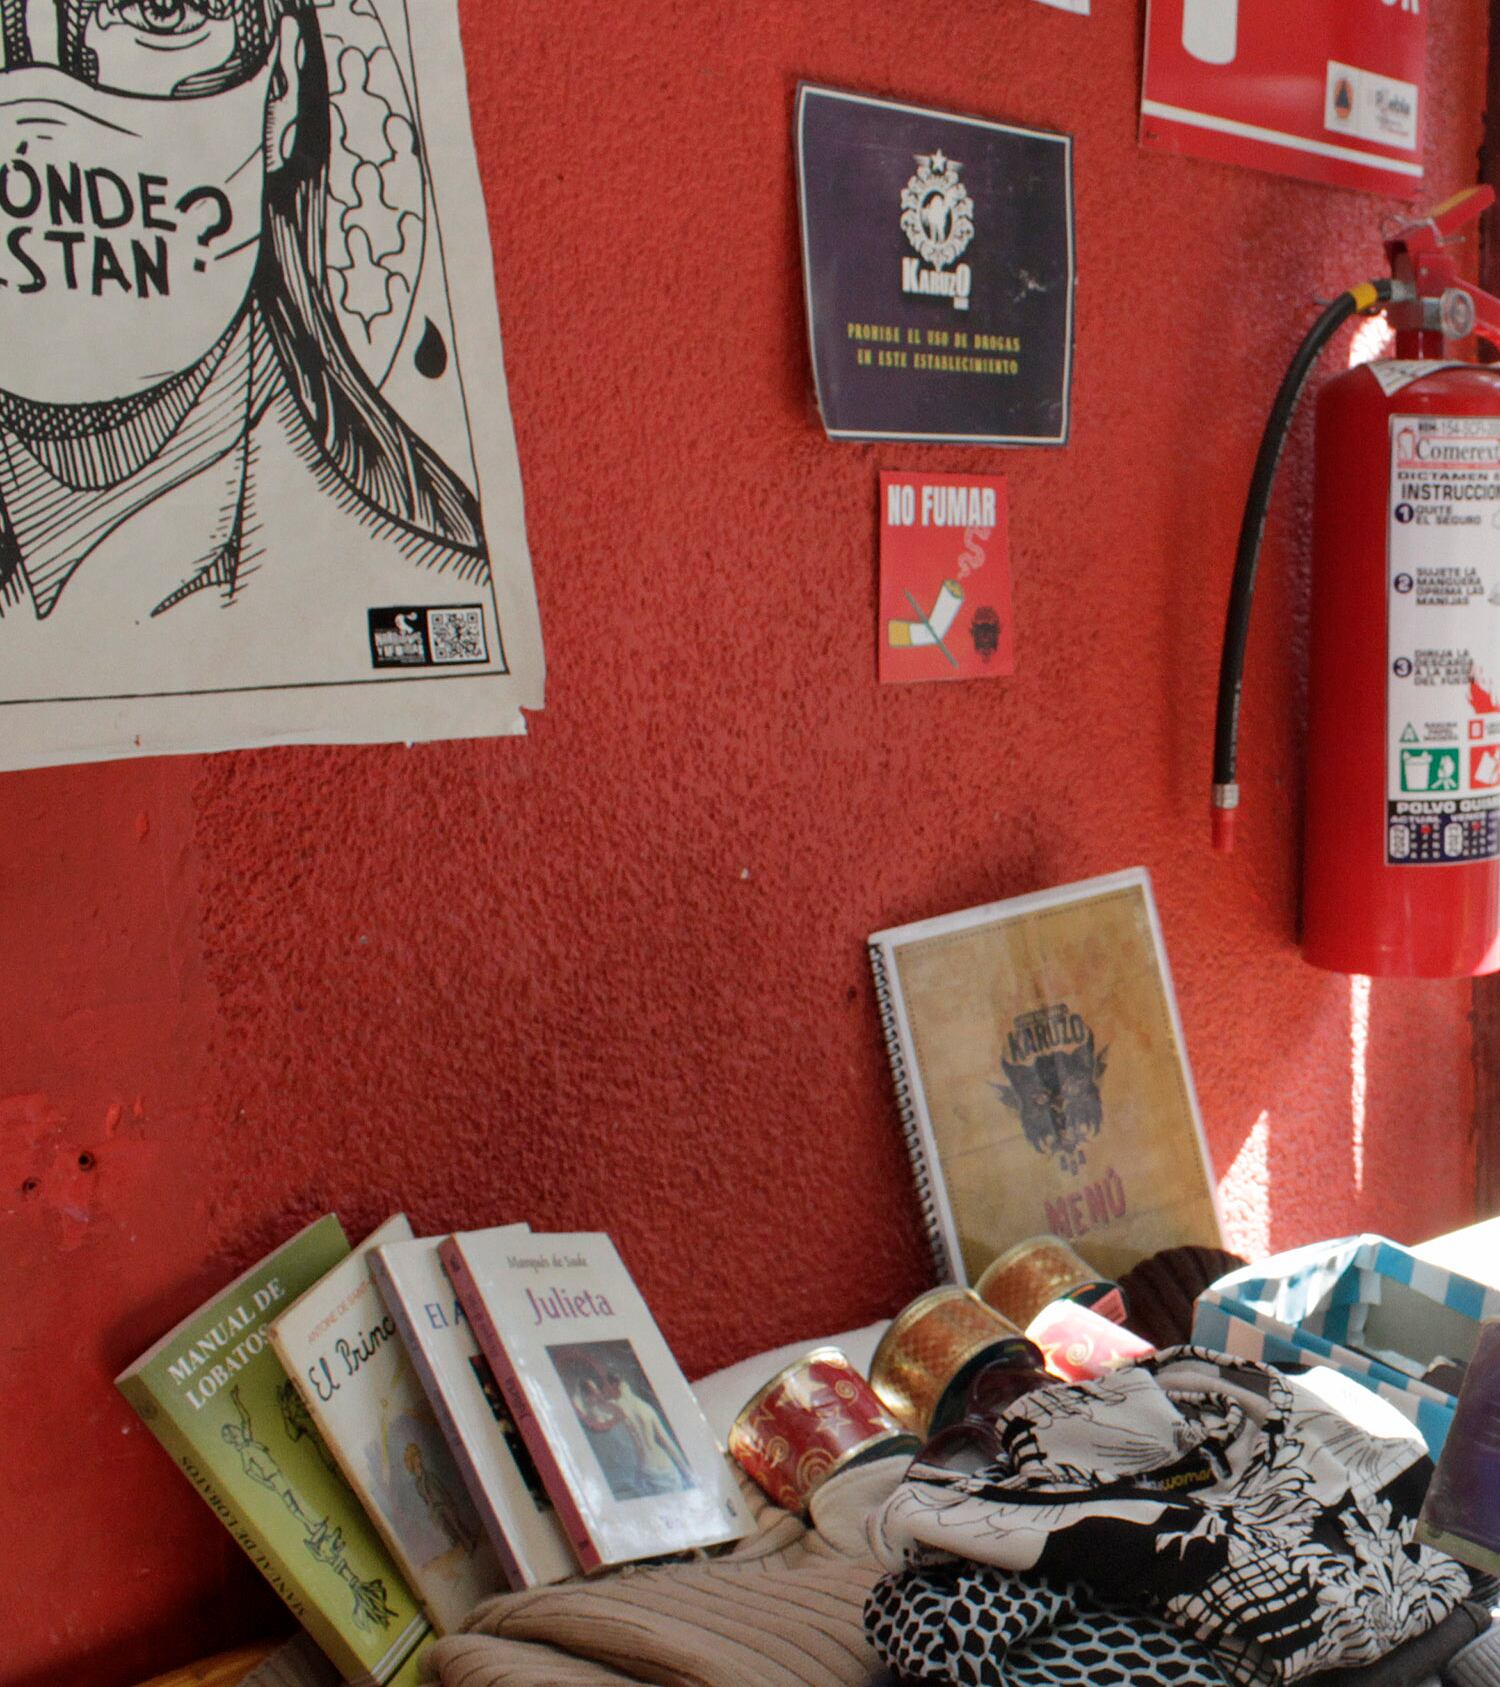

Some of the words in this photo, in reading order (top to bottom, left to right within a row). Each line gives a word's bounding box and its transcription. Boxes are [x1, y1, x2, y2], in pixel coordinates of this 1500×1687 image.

[847, 322, 900, 343] PROHIBE
[907, 328, 921, 345] EL
[927, 330, 948, 347] USO
[954, 332, 968, 349] DE
[974, 334, 1021, 352] DROGAS
[857, 349, 872, 366] EN
[878, 350, 907, 369] ESTE
[914, 353, 1019, 376] ESTABLECIMIENTO
[887, 484, 916, 526] NO
[921, 486, 996, 528] FUMAR
[1416, 504, 1453, 515] QUITE
[1396, 801, 1456, 814] POLVO
[424, 1303, 449, 1330] El
[525, 1287, 615, 1327] Julieta
[167, 1305, 256, 1386] MANUAL
[253, 1277, 286, 1311] DE
[185, 1322, 270, 1411] LOBATOS
[308, 1357, 341, 1401] El
